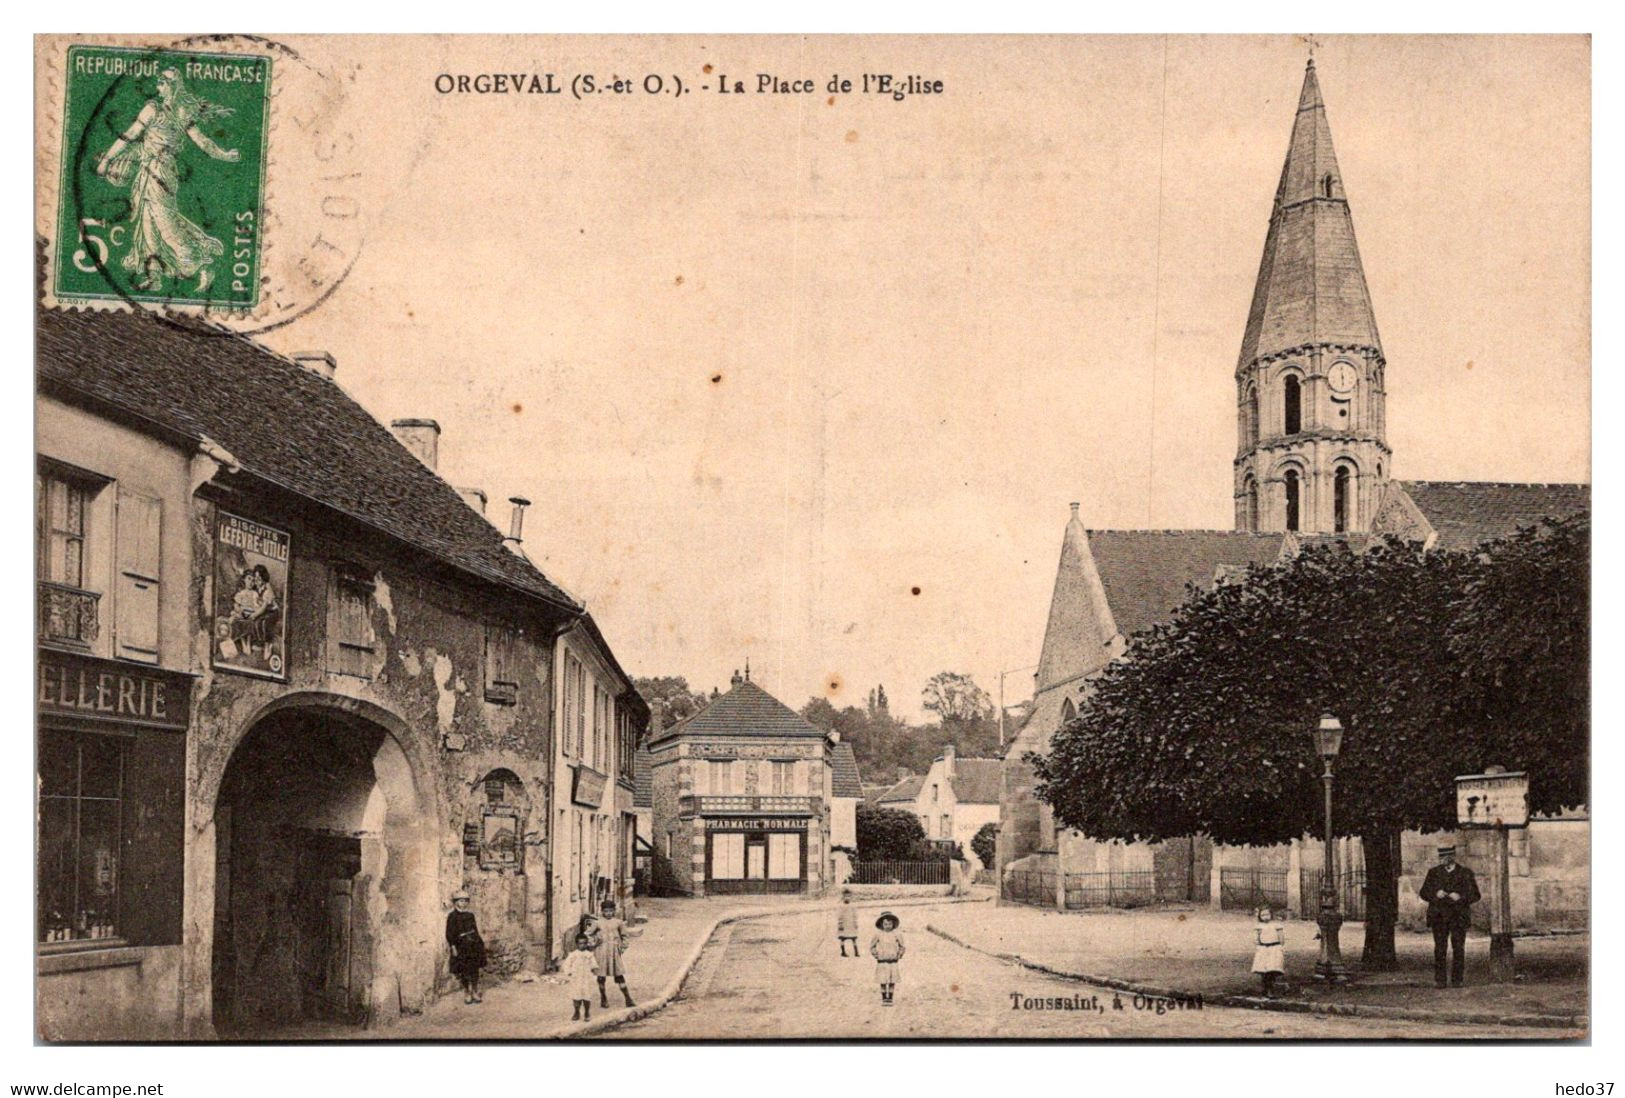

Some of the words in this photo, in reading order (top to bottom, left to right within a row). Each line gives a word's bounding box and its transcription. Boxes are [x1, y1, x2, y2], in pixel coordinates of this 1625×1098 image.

[231, 210, 254, 292] POSTES
[231, 518, 279, 541] BISCUITS
[39, 664, 168, 718] ELLERIE
[706, 819, 760, 829] PHARMACIE
[763, 819, 808, 829] NORMALE
